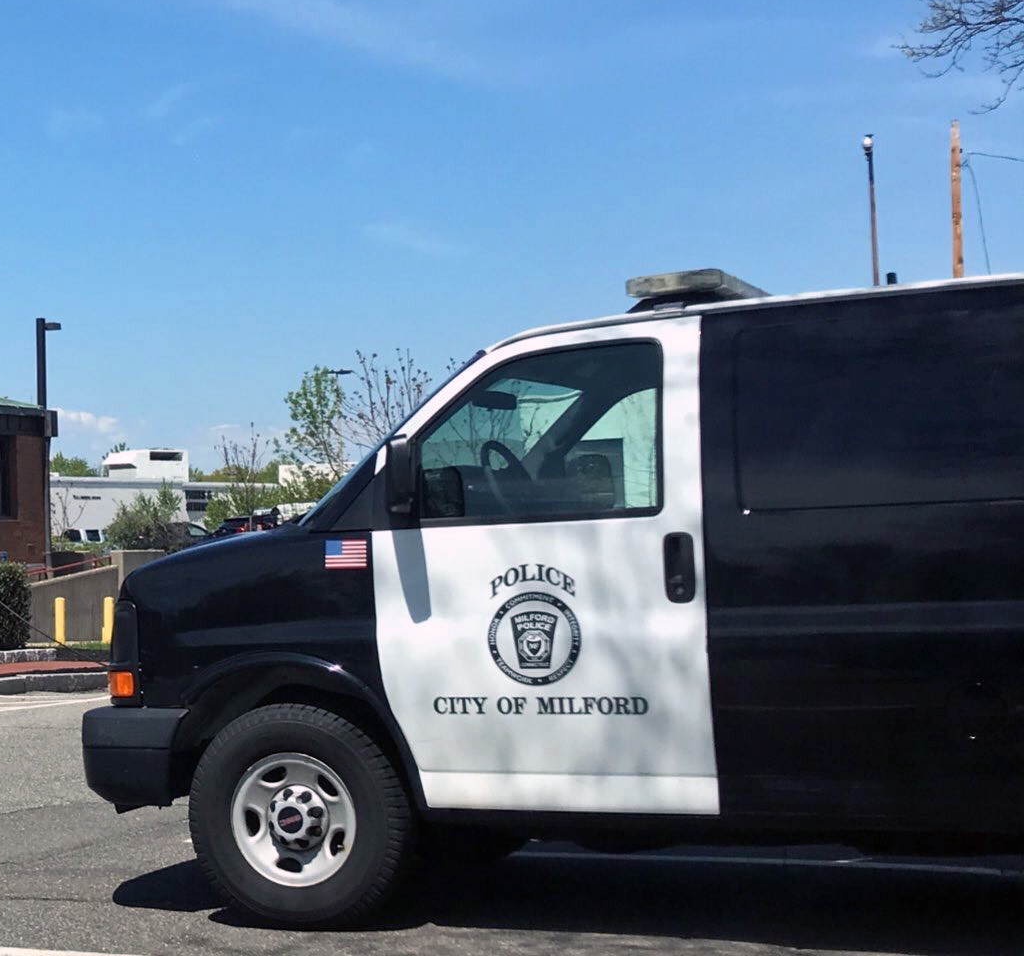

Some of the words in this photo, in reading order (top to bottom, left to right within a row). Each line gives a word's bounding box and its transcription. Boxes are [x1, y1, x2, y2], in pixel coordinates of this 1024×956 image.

[490, 563, 576, 599] POLICE
[514, 613, 556, 624] MILFORD
[516, 622, 552, 631] POLICE
[433, 696, 488, 715] CITY
[496, 696, 527, 715] OF
[536, 696, 649, 715] MILFORD
